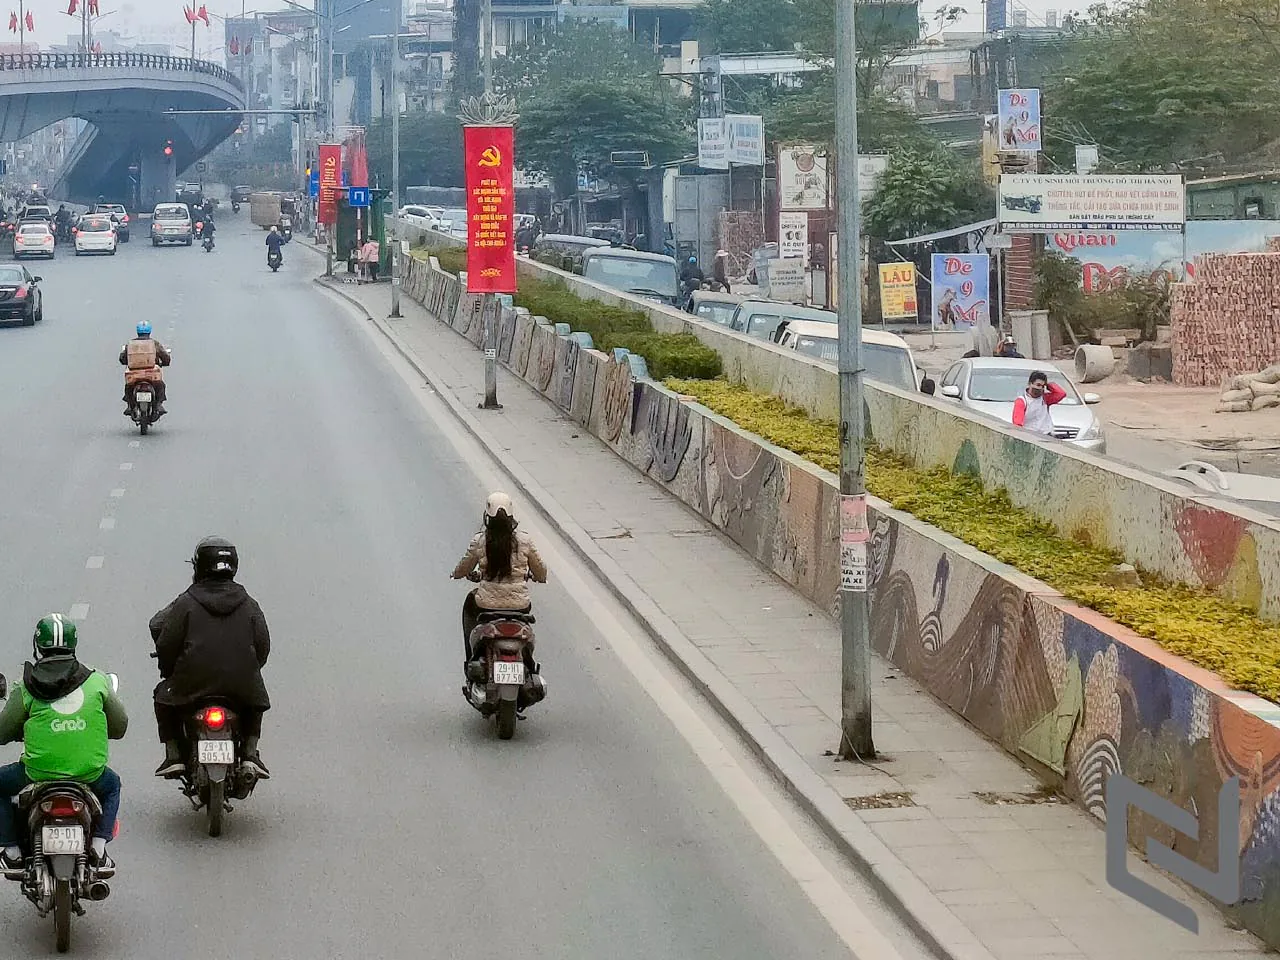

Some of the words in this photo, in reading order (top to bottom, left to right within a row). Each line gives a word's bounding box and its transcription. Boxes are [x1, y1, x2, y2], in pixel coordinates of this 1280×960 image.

[1019, 110, 1029, 124] 9
[960, 280, 974, 298] 9
[50, 716, 87, 733] Grab
